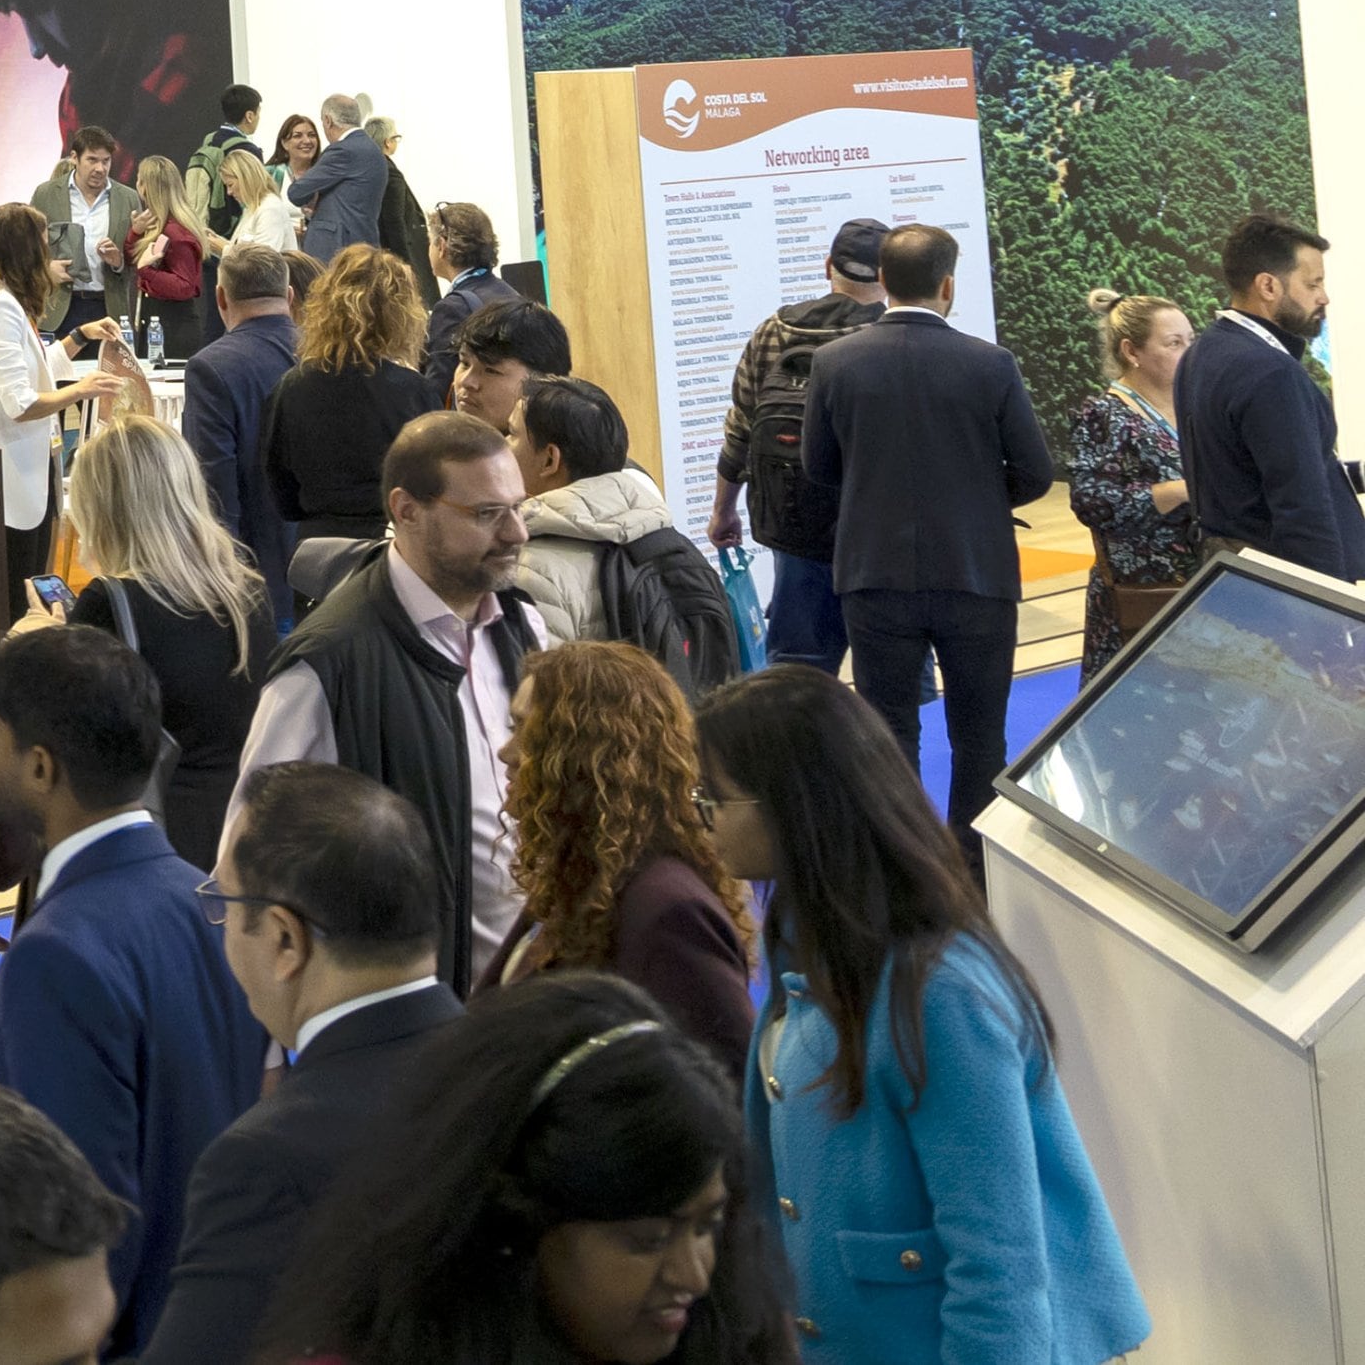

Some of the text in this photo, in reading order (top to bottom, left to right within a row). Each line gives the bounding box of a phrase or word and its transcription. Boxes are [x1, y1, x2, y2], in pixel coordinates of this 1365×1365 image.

[853, 75, 968, 95] www.visitcostadelsol.com
[704, 90, 767, 107] COSTA DEL SOL
[765, 145, 870, 169] Networking area
[664, 194, 679, 202] Town
[680, 192, 694, 201] Halls
[701, 190, 735, 200] Associations
[676, 357, 701, 367] MARBELLA
[682, 440, 695, 451] DMC
